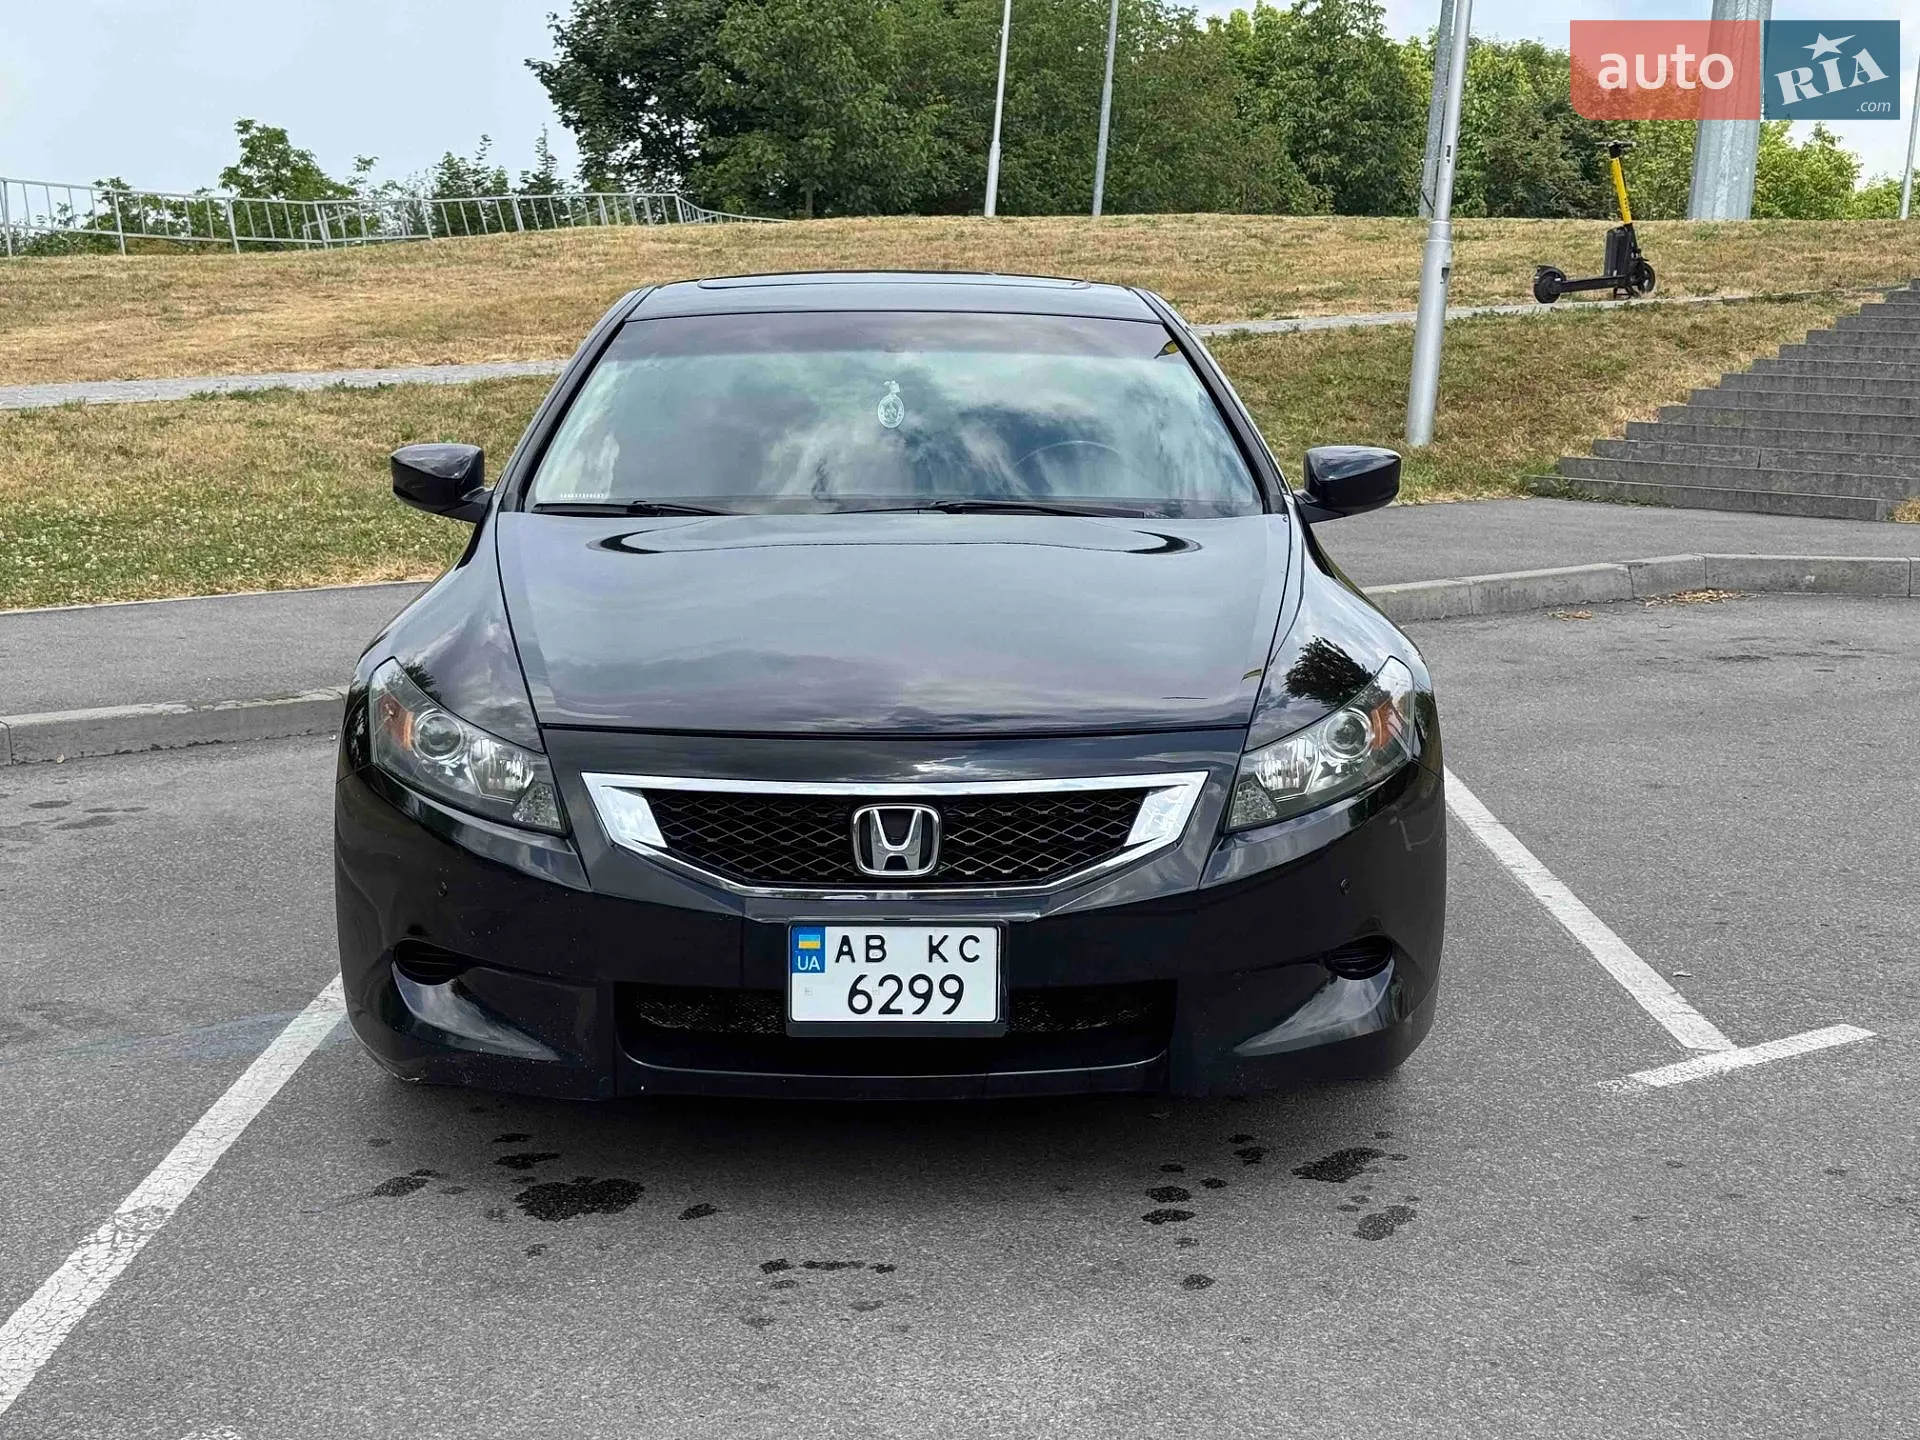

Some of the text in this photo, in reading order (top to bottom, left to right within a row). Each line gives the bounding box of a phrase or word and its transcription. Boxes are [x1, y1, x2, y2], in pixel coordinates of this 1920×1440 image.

[797, 955, 821, 971] UA
[835, 934, 981, 964] AB KC
[847, 973, 965, 1015] 6299
